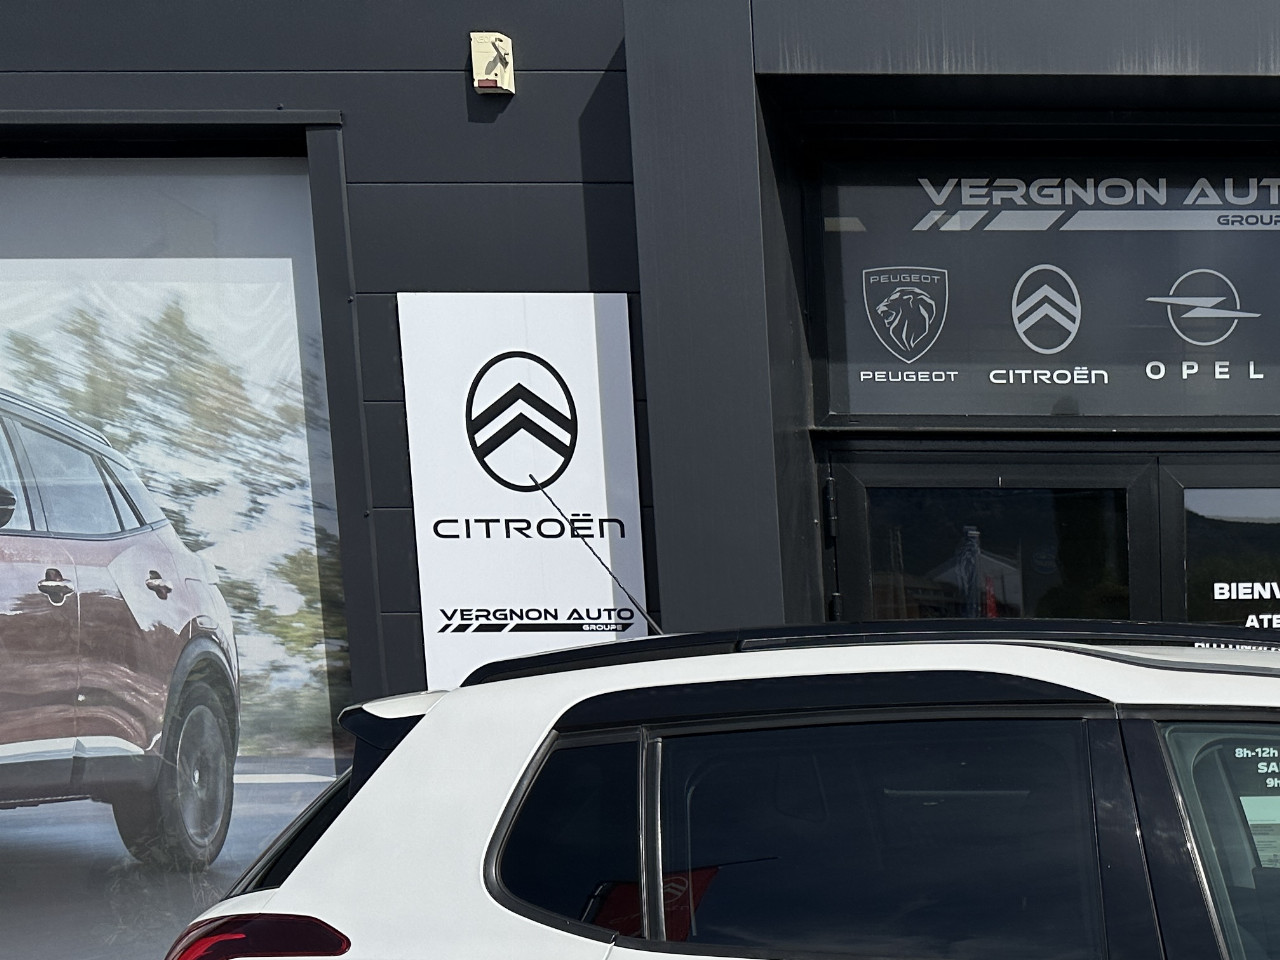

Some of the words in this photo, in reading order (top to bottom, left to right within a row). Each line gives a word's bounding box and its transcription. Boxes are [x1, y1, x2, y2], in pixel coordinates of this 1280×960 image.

[918, 177, 1167, 206] VERGNON
[870, 274, 941, 284] PEUGEOT
[860, 371, 958, 382] PEUGEOT
[989, 366, 1109, 384] CITROËN
[1145, 360, 1264, 380] OPEL
[433, 513, 626, 539] CITROËN
[439, 608, 558, 622] VERGNON
[566, 608, 635, 621] AUTO
[1235, 747, 1279, 758] 8h-12h
